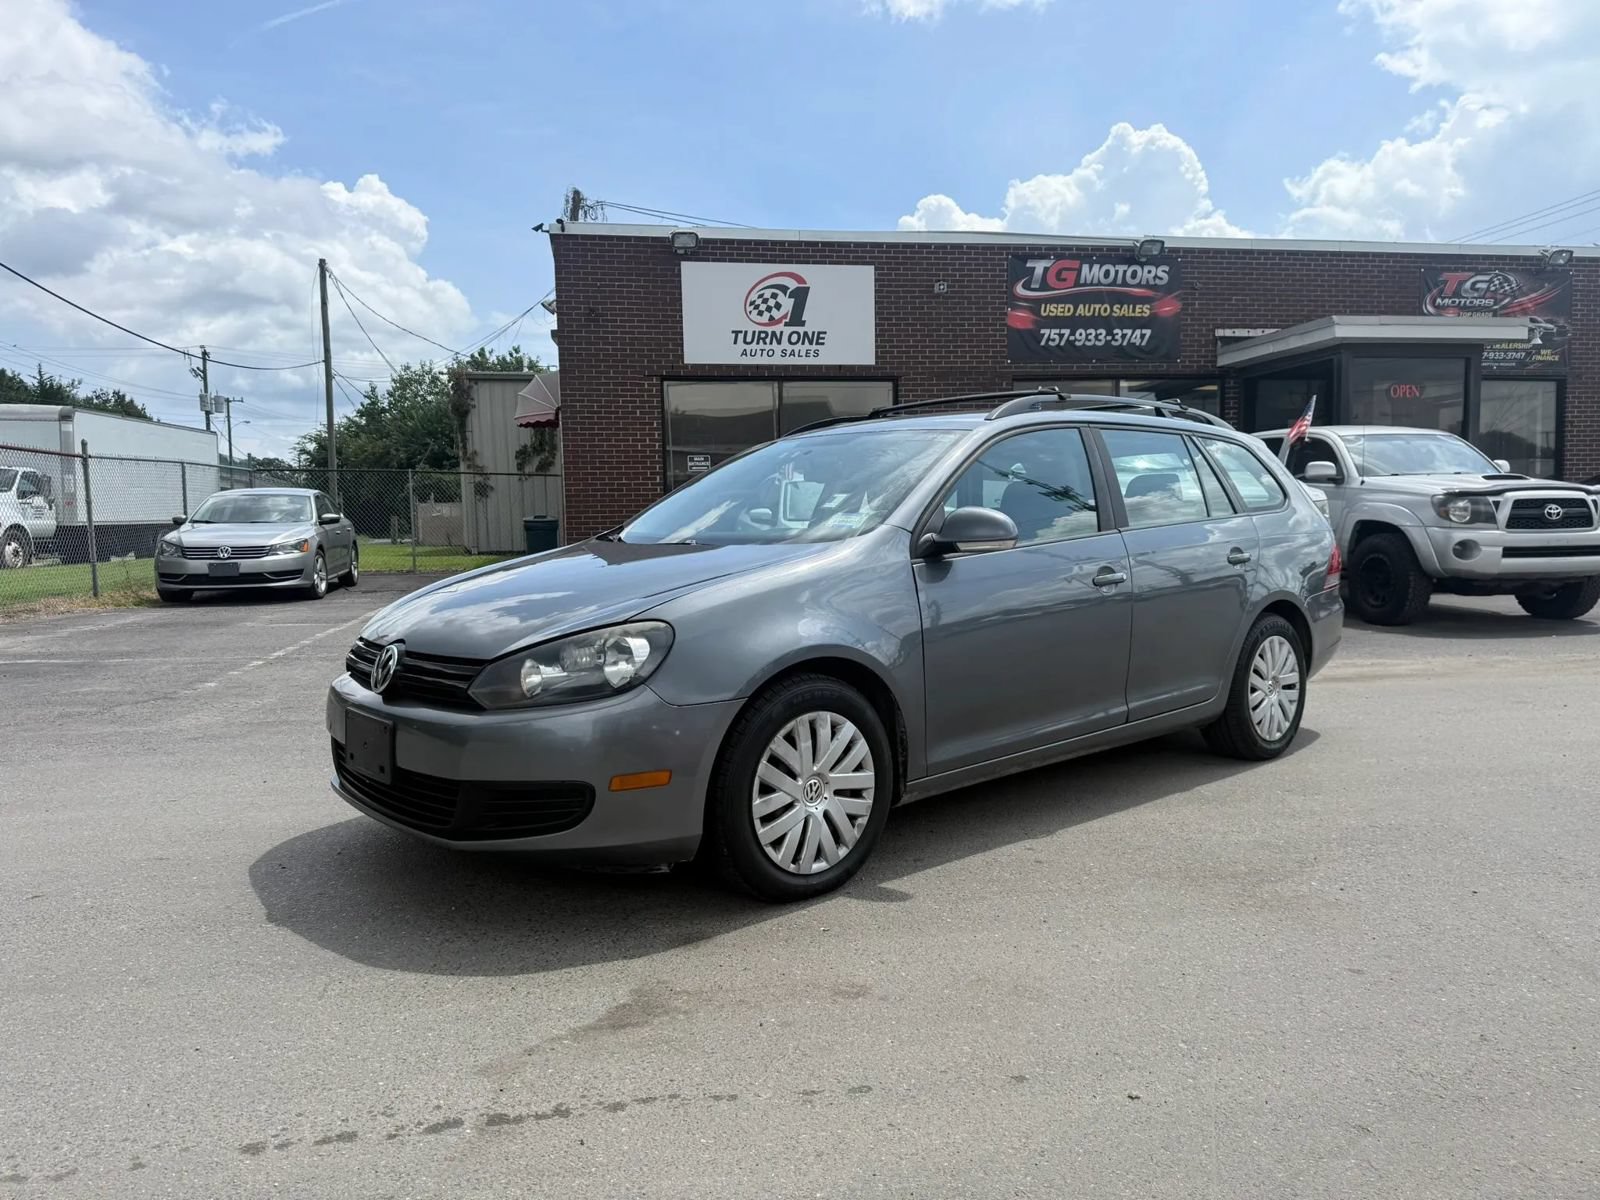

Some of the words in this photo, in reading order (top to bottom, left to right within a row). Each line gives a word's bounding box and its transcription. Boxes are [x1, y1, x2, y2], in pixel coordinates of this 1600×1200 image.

[1025, 259, 1081, 289] TG
[1079, 263, 1170, 286] MOTORS
[1434, 297, 1495, 308] MOTORS
[1040, 303, 1076, 317] USED
[1076, 304, 1111, 317] AUTO
[1112, 304, 1151, 318] SALES
[731, 330, 784, 346] TURN
[787, 330, 828, 346] ONE
[1039, 328, 1152, 347] 757-933-3747
[740, 348, 775, 358] AUTO
[780, 348, 820, 358] SALES
[1481, 351, 1526, 360] 7-933-3747
[1390, 384, 1420, 399] OPEN
